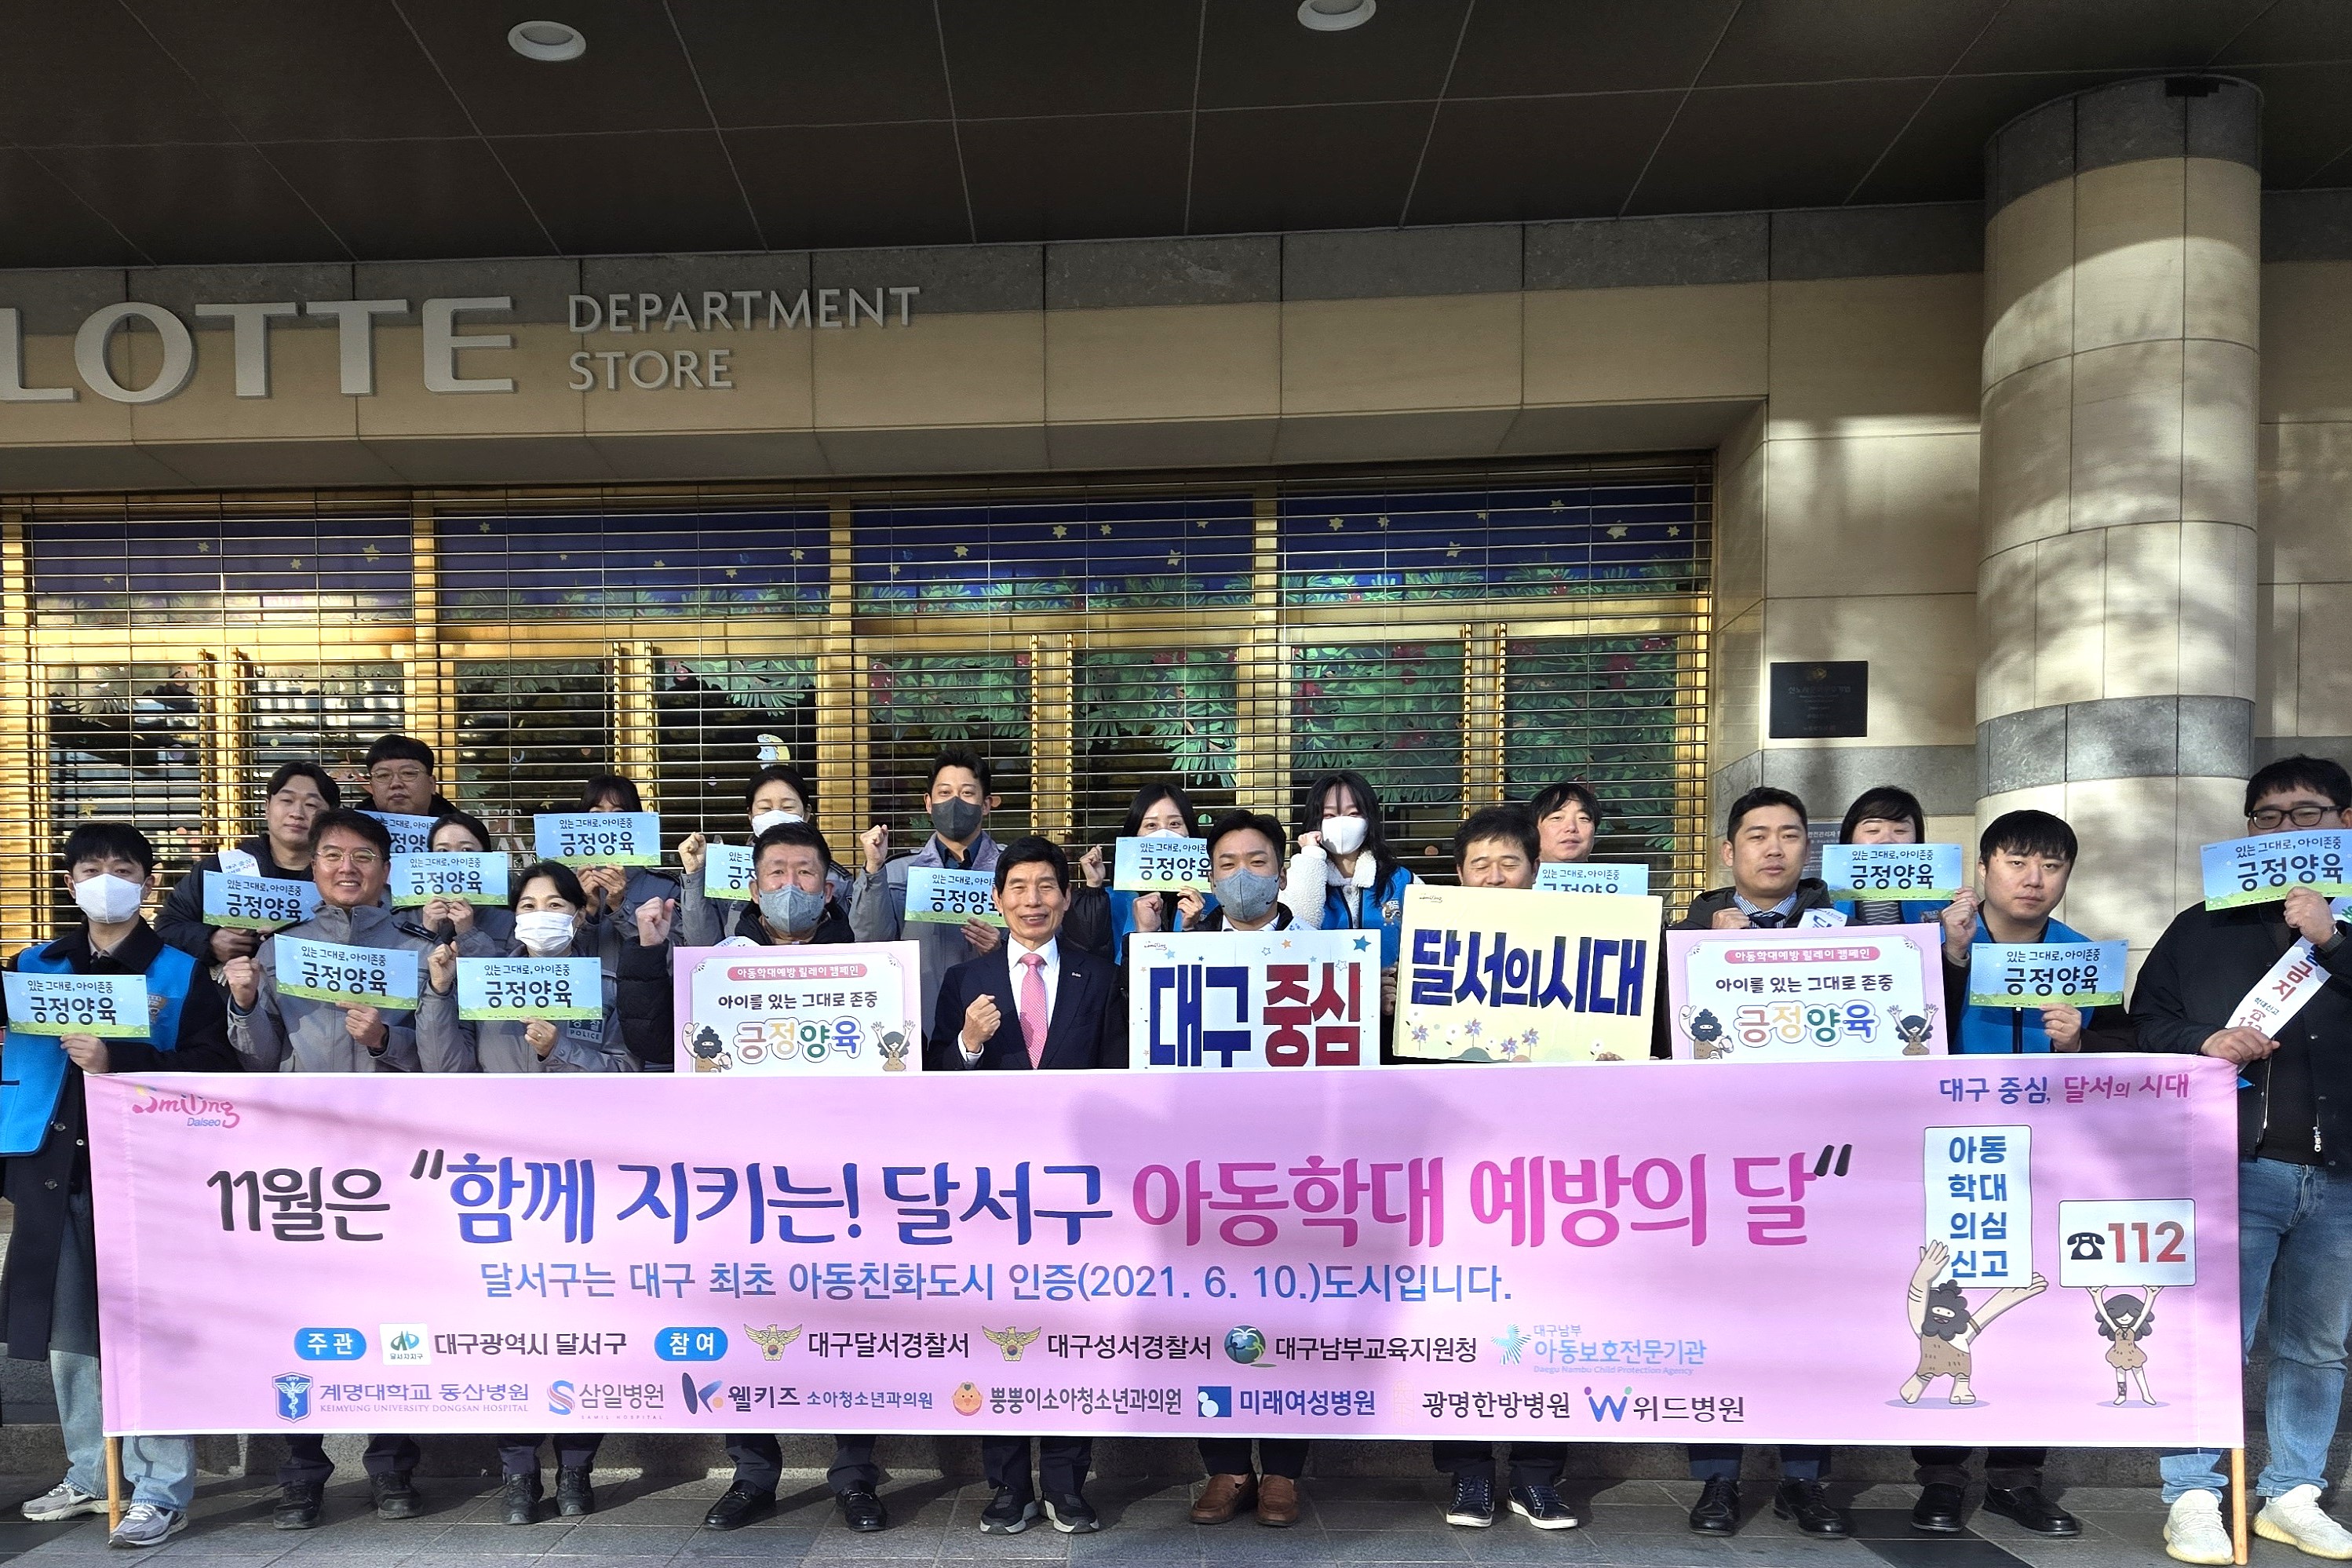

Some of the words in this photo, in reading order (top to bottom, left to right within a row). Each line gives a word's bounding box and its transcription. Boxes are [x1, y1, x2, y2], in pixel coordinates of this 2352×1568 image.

[568, 286, 921, 334] DEPARTMENT
[0, 296, 514, 402] LOTTE
[567, 348, 735, 392] STORE
[389, 819, 413, 830] 그대로,
[560, 818, 574, 830] 있는
[575, 819, 601, 828] 그대로,
[602, 818, 633, 829] 아이존중
[560, 831, 635, 857] 긍정양육
[729, 851, 742, 862] 있는
[1140, 842, 1154, 853] 있는
[1156, 842, 1182, 852] 그대로,
[1183, 844, 1207, 855] 아이존
[1851, 850, 1869, 861] 있는
[1870, 850, 1899, 860] 그대로,
[1899, 849, 1934, 861] 아이존중
[2236, 844, 2256, 859] 있는
[2258, 839, 2296, 853] 그대로,
[2298, 836, 2342, 850] 아이존중
[410, 858, 424, 869] 있는
[425, 858, 450, 867] 그대로,
[450, 857, 481, 869] 아이존중
[1542, 869, 1558, 879] 있는
[1559, 870, 1587, 878] 그대로,
[1588, 869, 1620, 881] 아이존중
[2237, 853, 2344, 892] 긍정양육
[227, 879, 242, 890] 있는
[243, 881, 269, 892] 그대로,
[270, 884, 301, 897] 아이존중
[410, 870, 483, 895] 긍정양육
[932, 873, 946, 884] 있는
[948, 874, 974, 886] 그대로,
[1850, 863, 1935, 890] 긍정양육
[226, 893, 302, 923] 긍정양육
[301, 946, 318, 958] 있는
[319, 949, 349, 961] 그대로,
[350, 953, 386, 967] 아이존중
[1735, 950, 1800, 962] 아동학대예방
[1804, 948, 1835, 961] 릴레이
[1837, 947, 1870, 960] 캠페인
[2007, 950, 2026, 963] 있는
[2029, 950, 2064, 961] 그대로,
[2065, 948, 2101, 962] 아이존중
[301, 961, 388, 997] 긍정양육
[484, 964, 501, 976] 있는
[503, 965, 533, 975] 그대로,
[534, 964, 571, 976] 아이존중
[738, 967, 796, 979] 아동학대예방
[799, 966, 827, 979] 릴레이
[830, 965, 859, 976] 캠페인
[2004, 965, 2099, 997] 긍정양육
[27, 979, 44, 992] 있는
[46, 981, 75, 992] 그대로,
[76, 981, 113, 994] 아이존중
[485, 979, 572, 1008] 긍정양육
[1716, 977, 1765, 994] 아이를
[1770, 976, 1803, 993] 있는
[1807, 975, 1857, 990] 그대로
[1861, 974, 1894, 992] 존중
[30, 997, 117, 1026] 긍정양육
[718, 994, 763, 1010] 아이를
[768, 994, 797, 1009] 있는
[802, 992, 845, 1008] 그대로
[850, 990, 878, 1008] 존중
[1149, 965, 1252, 1067] 대구
[1264, 961, 1360, 1067] 중심
[1738, 1004, 1876, 1043] 긍정양육
[570, 1029, 600, 1040] POLICE
[738, 1020, 861, 1059] 긍정양육
[1939, 1078, 1990, 1103] 대구
[1997, 1077, 2051, 1105] 중심,
[2064, 1076, 2130, 1101] 달서의
[2139, 1074, 2190, 1099] 시대
[187, 1118, 221, 1127] Dalseo
[1948, 1136, 2007, 1164] 아동
[1948, 1173, 2007, 1202] 학대
[207, 1167, 391, 1242] 11월은
[617, 1161, 862, 1245] 지키는!
[882, 1161, 1114, 1245] 달서구
[1132, 1155, 1444, 1248] 아동학대
[1470, 1154, 1707, 1248] 예방의
[1949, 1211, 2007, 1240] 의심
[2108, 1220, 2186, 1264] 112
[1950, 1249, 2009, 1278] 신고
[481, 1262, 616, 1300] 달서구는
[630, 1262, 695, 1300] 대구
[709, 1262, 776, 1300] 최초
[789, 1262, 994, 1301] 아동친화도시
[1009, 1263, 1190, 1303] 인증(2021.
[1204, 1267, 1238, 1300] 6.
[1255, 1264, 1511, 1303] 10.)도시입니다.
[1533, 1324, 1582, 1337] 대구남부
[434, 1333, 548, 1355] 대구광역시
[556, 1333, 627, 1355] 달서구
[808, 1332, 969, 1358] 대구달서경찰서
[1048, 1333, 1211, 1359] 대구성서경찰서
[1275, 1336, 1477, 1363] 대구남부교육지원청
[1534, 1339, 1707, 1365] 아동보호전문기관
[1533, 1366, 1559, 1375] Daegu
[1662, 1367, 1695, 1377] Agency
[319, 1384, 432, 1402] 계명대학교
[438, 1384, 529, 1402] 동산병원
[579, 1384, 664, 1409] 삼일병원
[728, 1386, 800, 1412] 웰키즈
[807, 1391, 933, 1409] 소아청소년과의원
[990, 1387, 1181, 1414] 뿡뿡이소아청소년과의원
[1240, 1389, 1375, 1416] 미래여성병원
[1422, 1391, 1570, 1419] 광명한방병원
[1633, 1396, 1745, 1423] 위드병원
